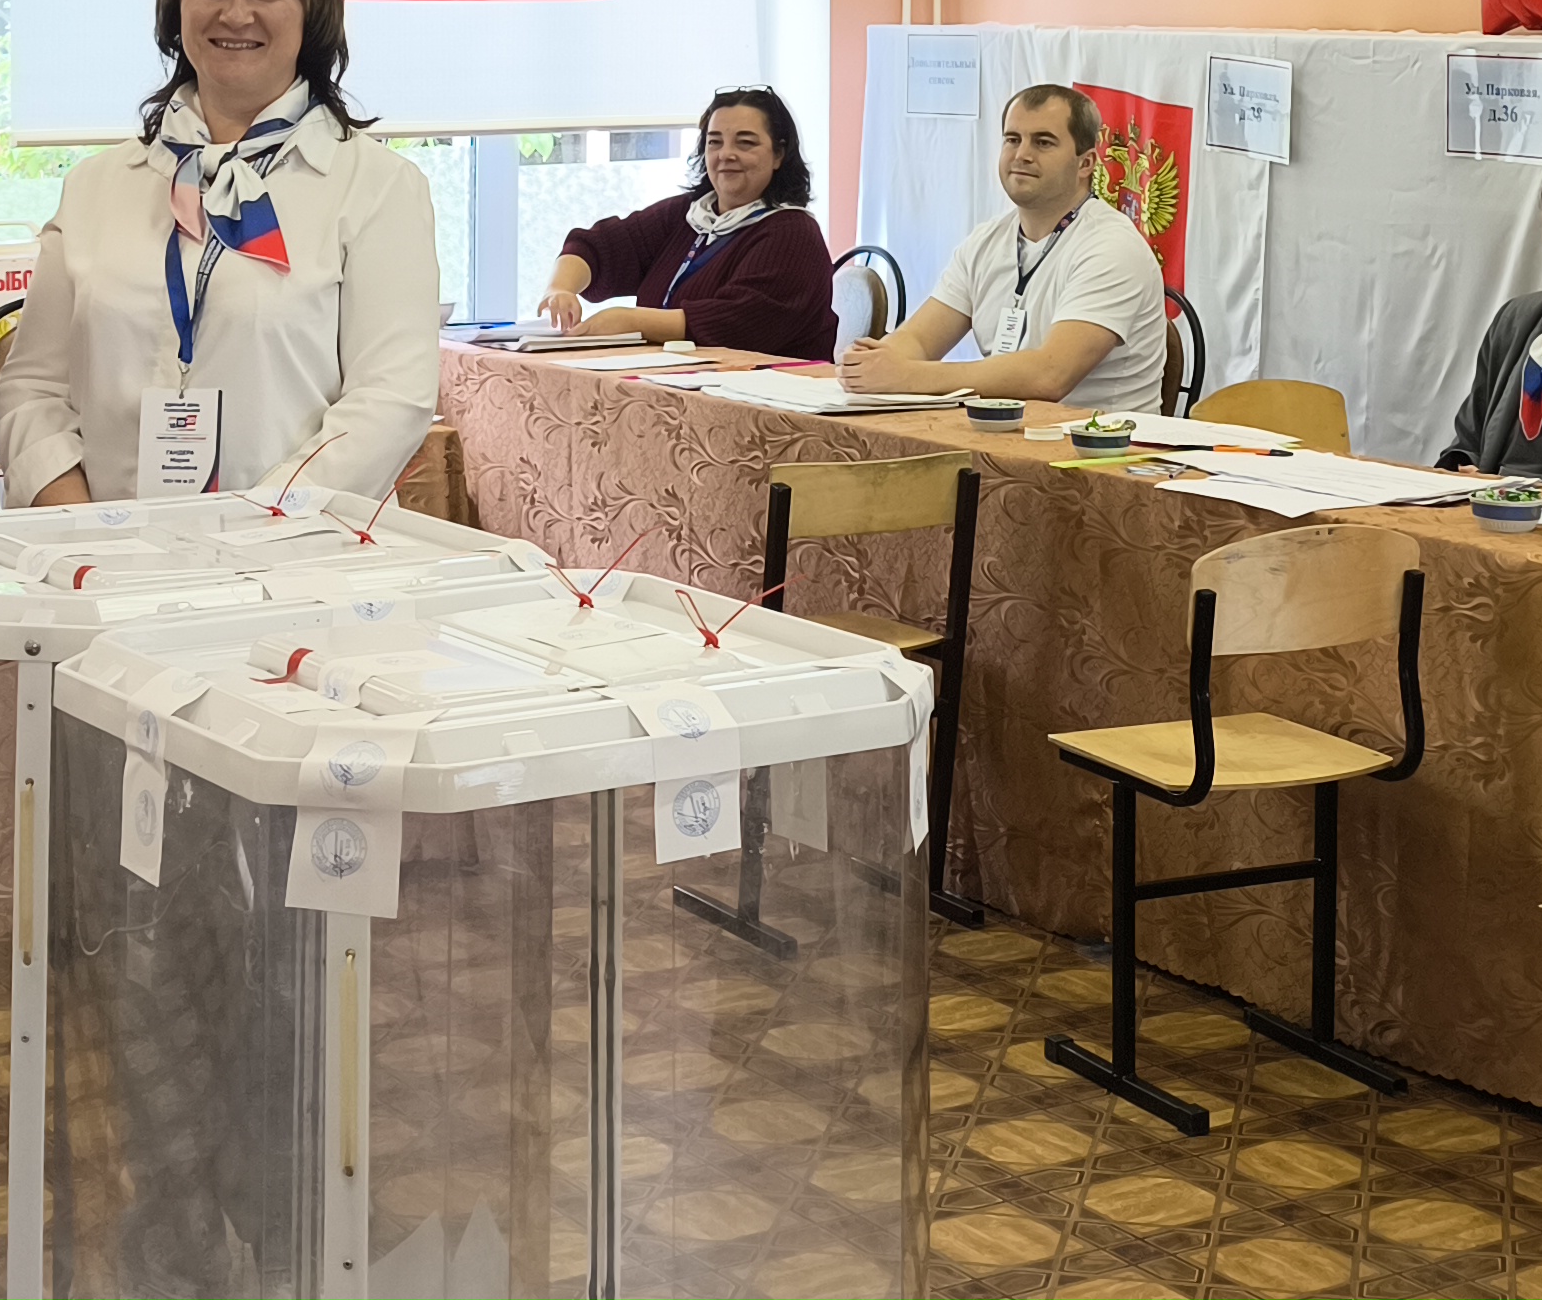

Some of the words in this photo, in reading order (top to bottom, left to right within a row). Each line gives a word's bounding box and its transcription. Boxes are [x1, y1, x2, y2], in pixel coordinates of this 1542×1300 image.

[928, 76, 956, 85] список
[1486, 83, 1541, 100] Парковая,
[1487, 104, 1519, 123] д.36
